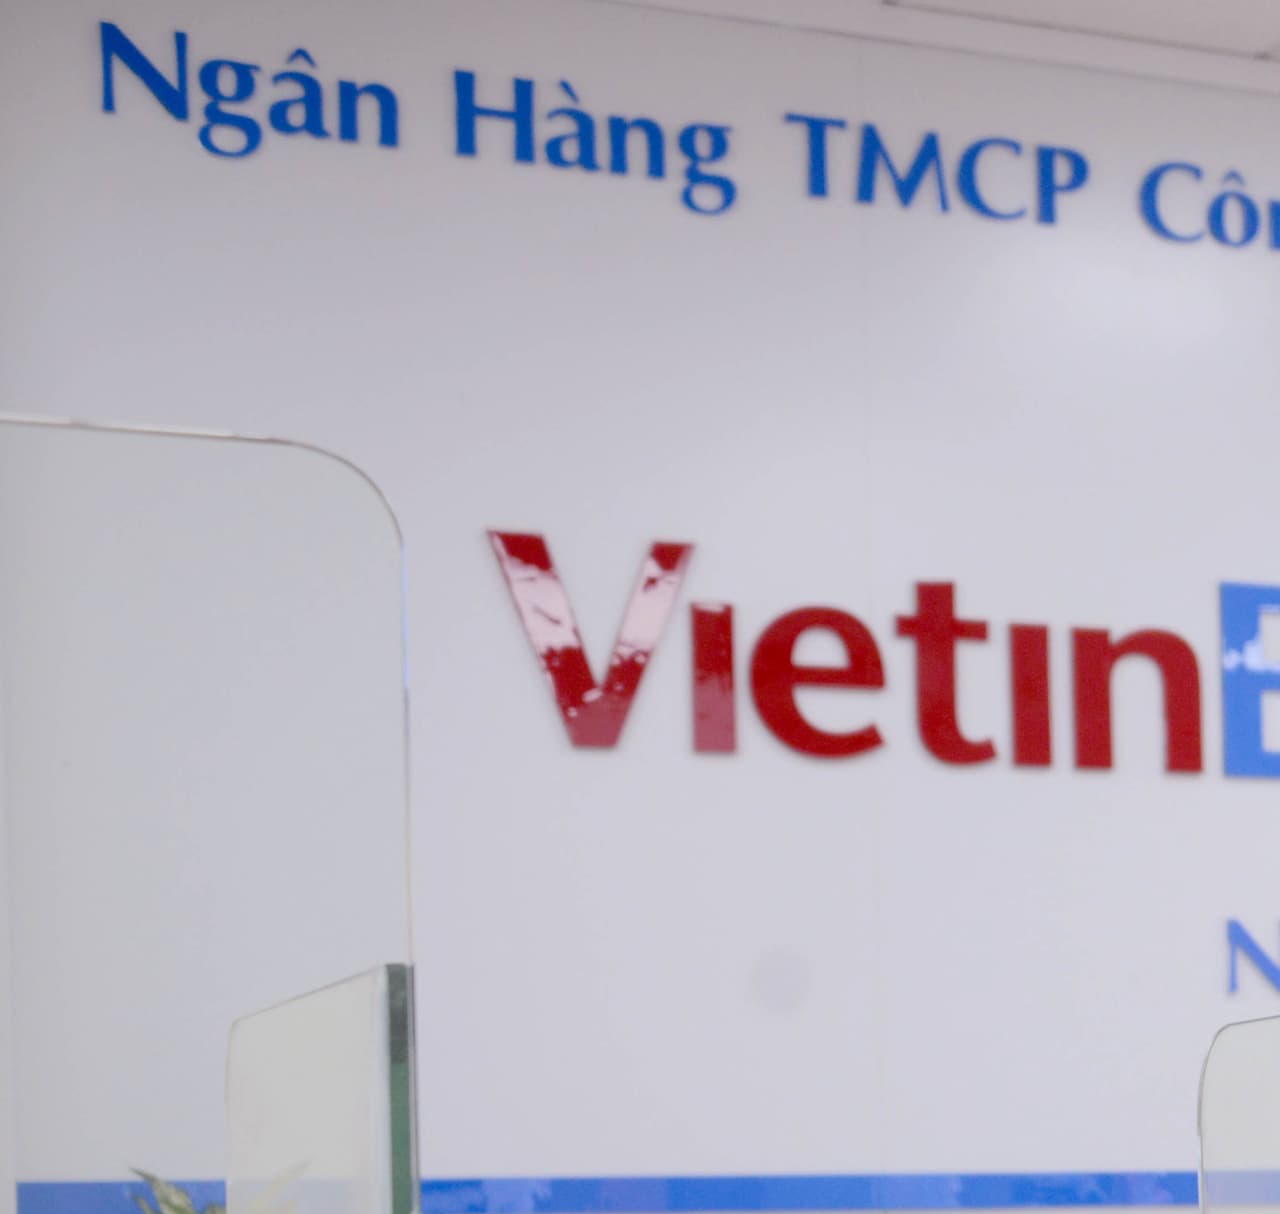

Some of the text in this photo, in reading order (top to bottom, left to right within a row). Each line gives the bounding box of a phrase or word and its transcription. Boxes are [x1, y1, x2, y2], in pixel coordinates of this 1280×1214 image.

[98, 20, 402, 158] Ngân
[451, 69, 738, 216] Hàng
[783, 112, 1092, 226] TMCP
